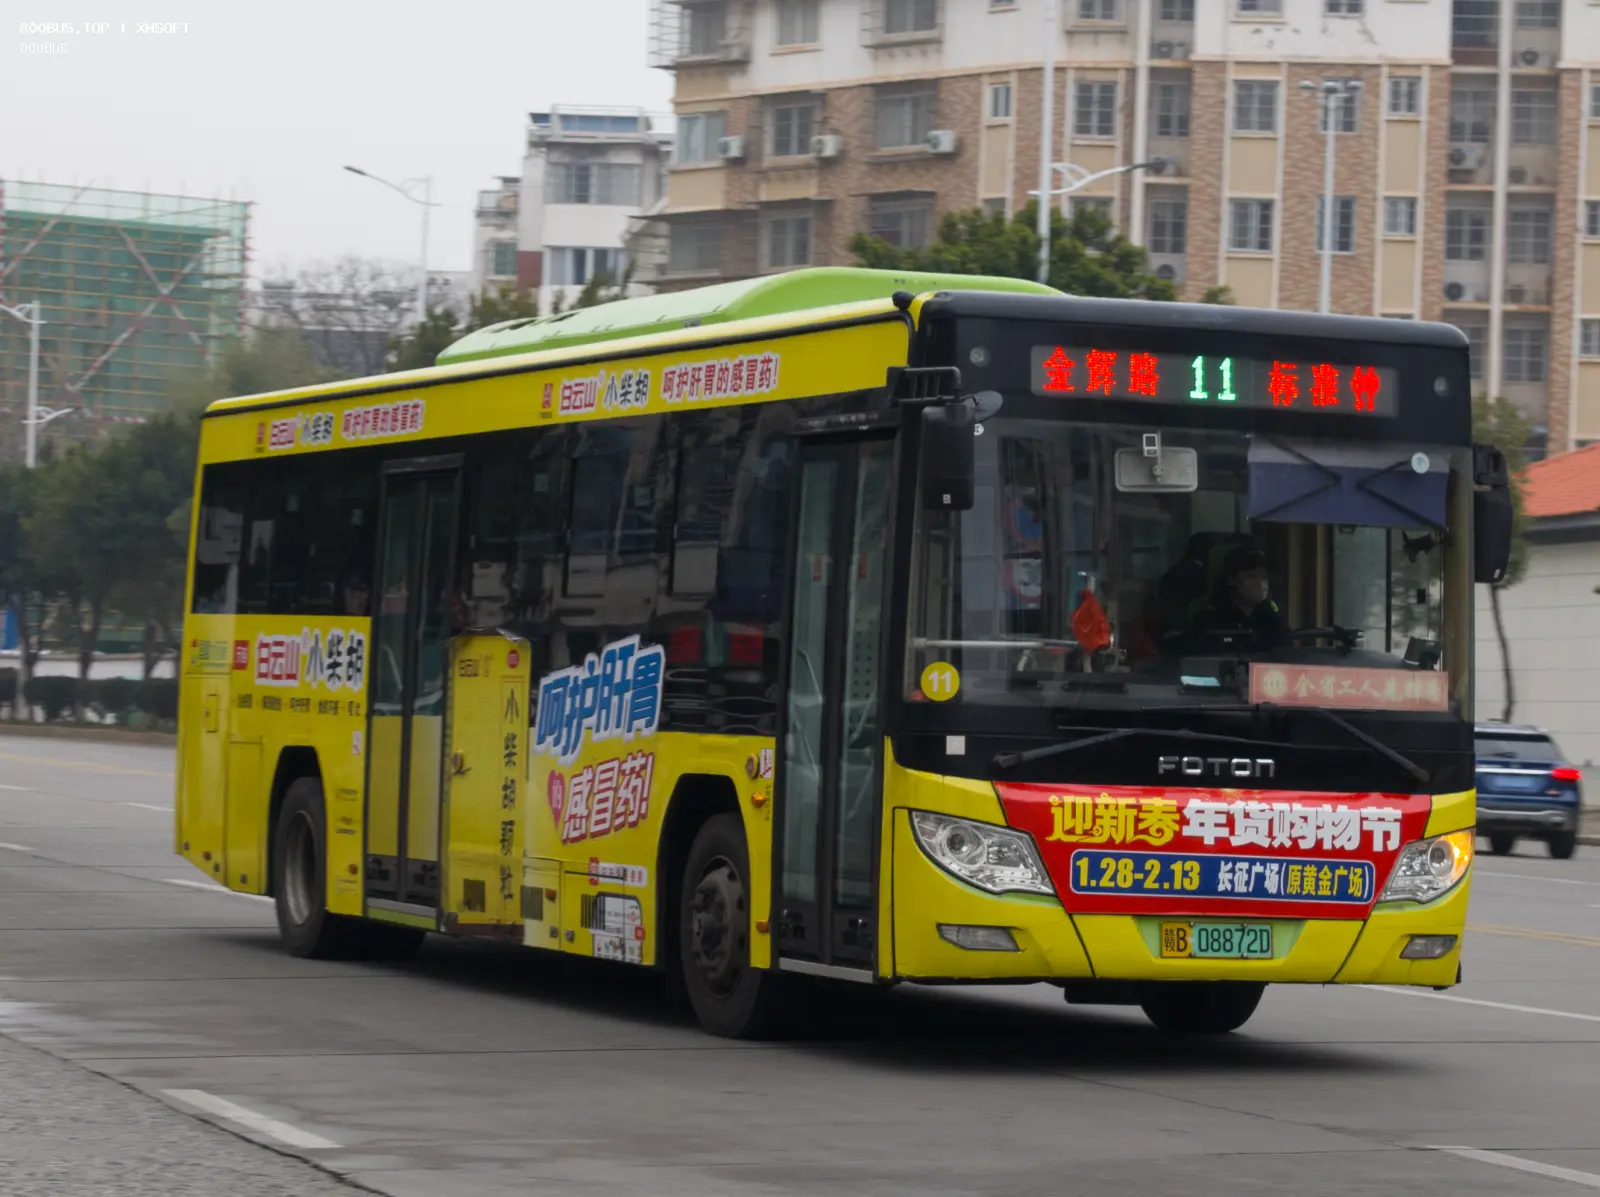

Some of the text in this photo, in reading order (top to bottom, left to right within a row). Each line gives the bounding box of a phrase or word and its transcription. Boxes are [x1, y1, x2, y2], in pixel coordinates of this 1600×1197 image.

[560, 381, 597, 411] 白云山
[603, 371, 650, 407] 小柴胡
[1190, 356, 1236, 400] 11
[257, 640, 300, 681] 白云山
[305, 631, 364, 685] 小柴胡
[534, 639, 663, 760] 呵护肝胃
[928, 669, 952, 692] 11
[1158, 756, 1275, 777] FOTON
[1076, 857, 1200, 890] 1.28-2.13
